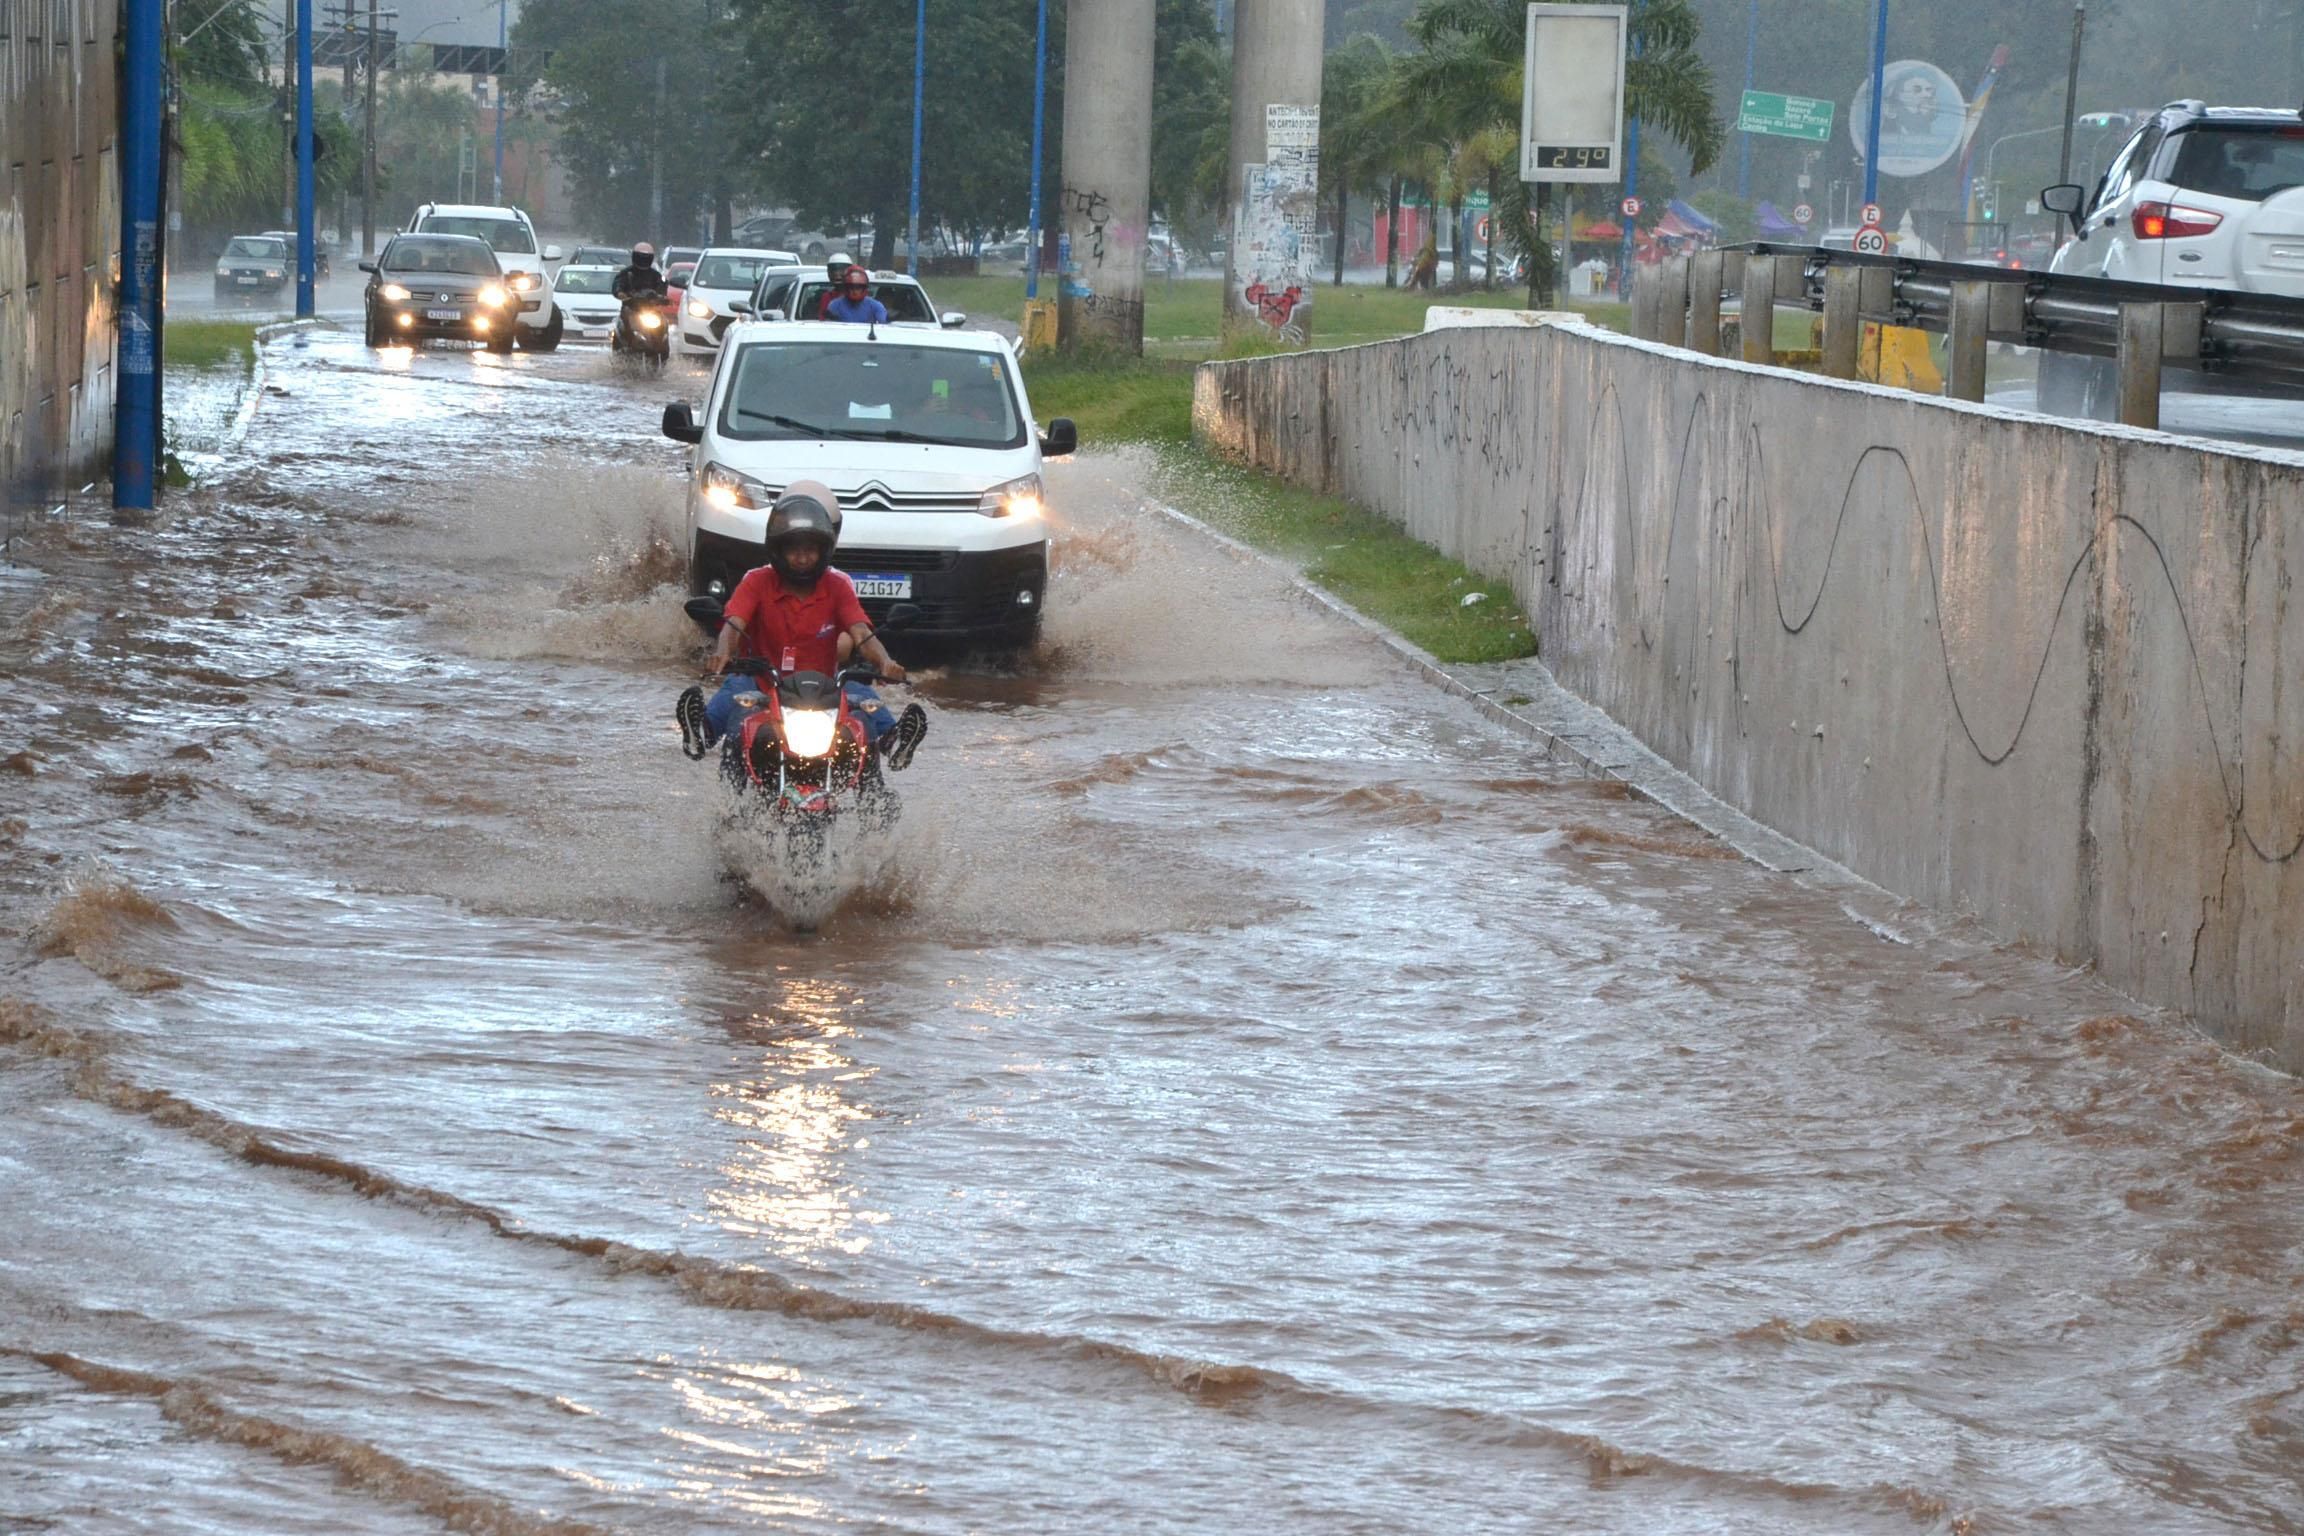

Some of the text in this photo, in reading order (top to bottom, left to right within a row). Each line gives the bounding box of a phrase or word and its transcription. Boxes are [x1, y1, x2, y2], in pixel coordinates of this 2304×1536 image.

[1796, 208, 1810, 218] 60
[1859, 236, 1883, 250] 60
[855, 582, 902, 596] Z1G17
